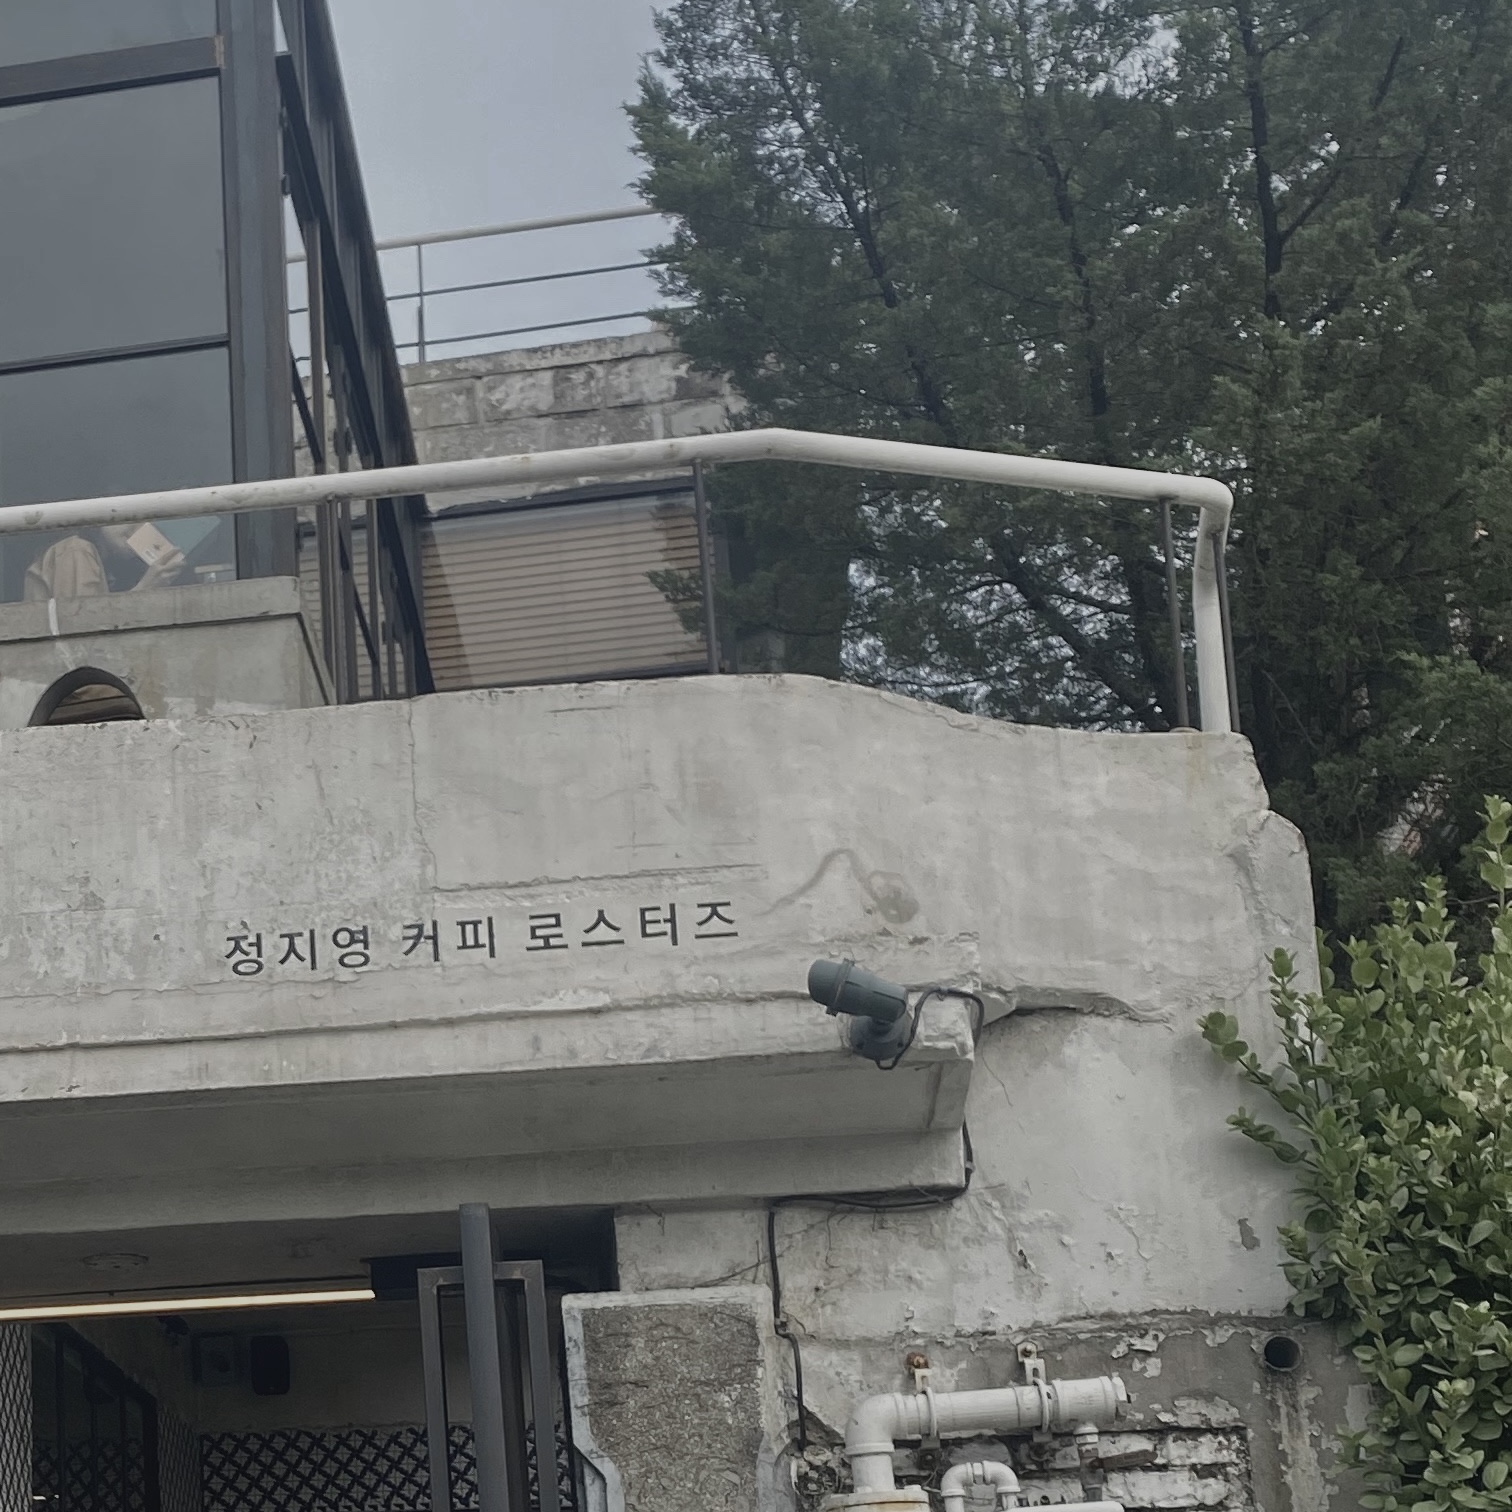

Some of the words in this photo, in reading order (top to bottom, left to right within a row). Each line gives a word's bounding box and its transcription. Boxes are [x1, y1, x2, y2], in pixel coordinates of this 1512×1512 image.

[224, 924, 371, 976] 정지영
[401, 916, 497, 962] 커피
[526, 901, 738, 951] 로스터즈
